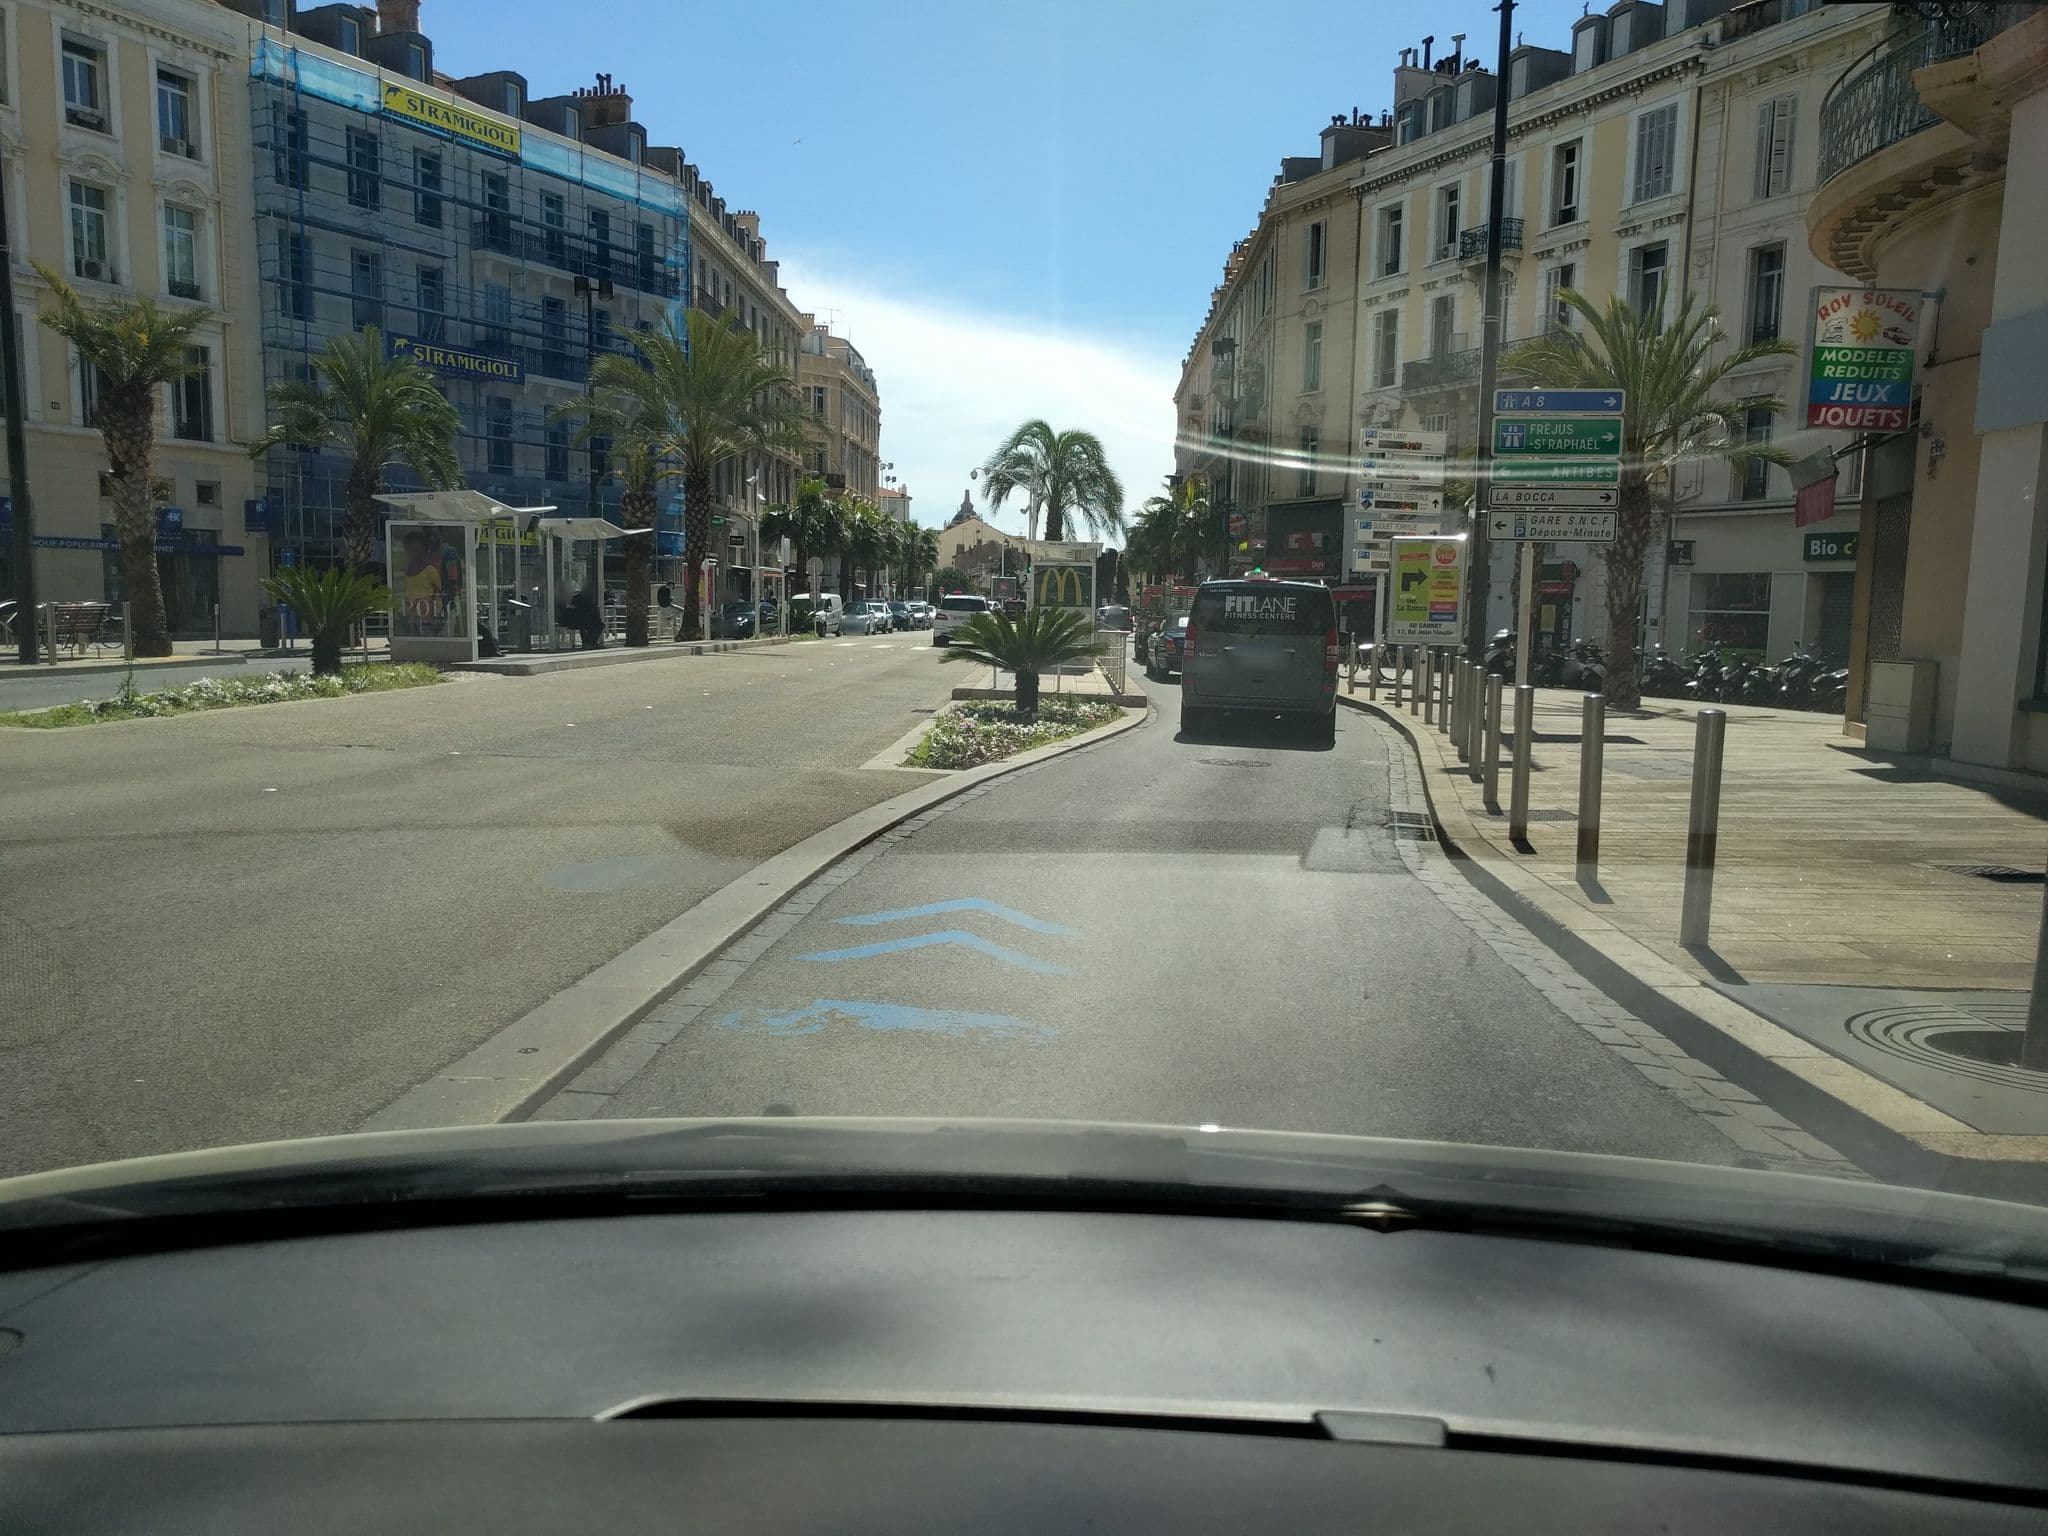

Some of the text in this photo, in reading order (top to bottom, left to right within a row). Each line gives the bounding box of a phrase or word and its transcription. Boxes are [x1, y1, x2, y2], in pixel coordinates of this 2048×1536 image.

[406, 96, 514, 146] STRAMIGIOLI
[1863, 291, 1916, 322] SOLEIL
[413, 344, 519, 378] STRAMIGIOLI
[1820, 349, 1906, 364] MODELES
[1823, 365, 1902, 380] REDUITS
[1830, 383, 1891, 402] JEUX
[1521, 396, 1545, 407] A 8
[1814, 407, 1903, 428] JOUETS
[1529, 423, 1574, 435] FRÉJUS
[1548, 437, 1600, 450] RAPHAËL
[1551, 466, 1614, 478] ANTIBES
[1495, 493, 1555, 502] LA BOCCA
[1530, 515, 1561, 525] GARE
[1810, 539, 1838, 555] Bio
[1406, 604, 1428, 612] Bocca
[1259, 613, 1296, 621] CENTERS
